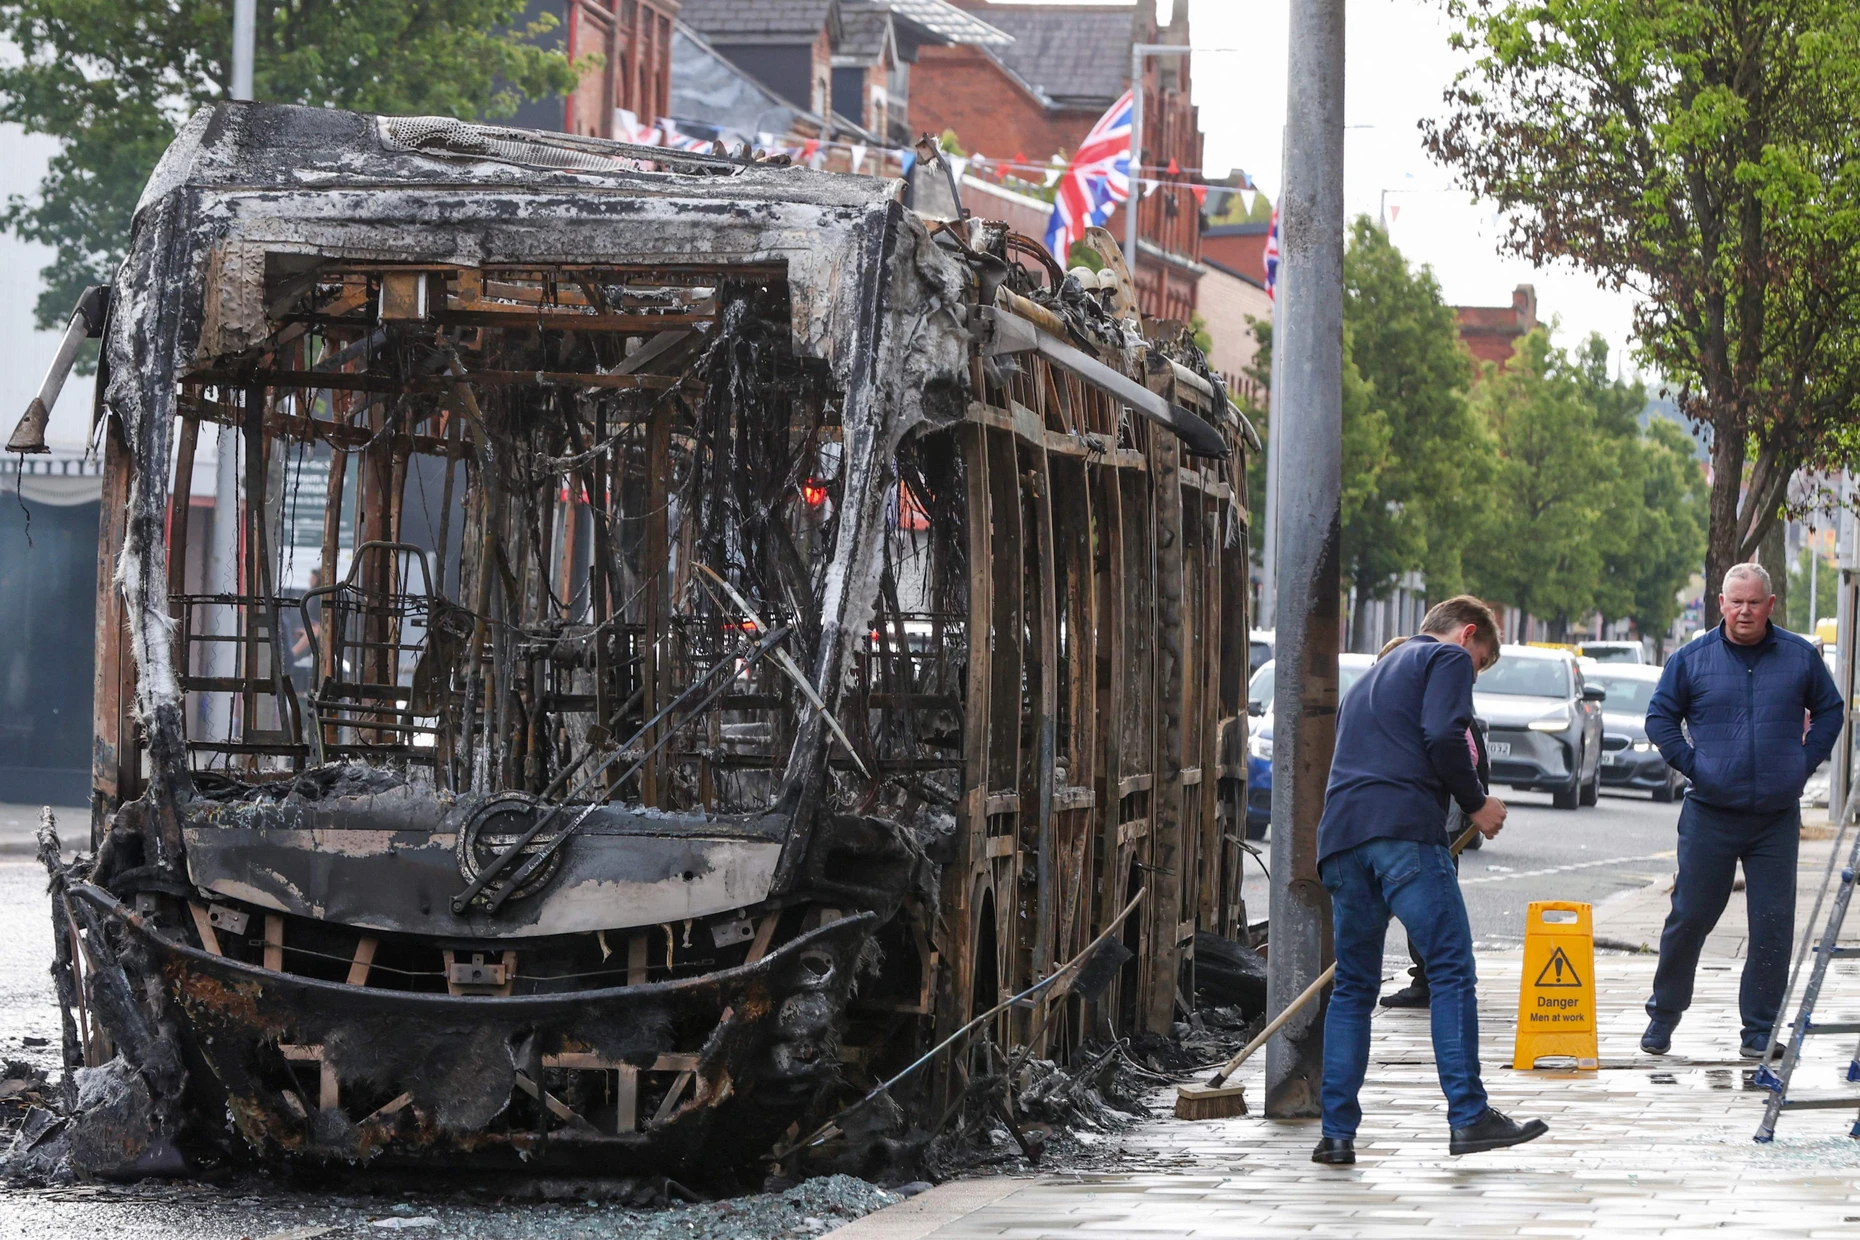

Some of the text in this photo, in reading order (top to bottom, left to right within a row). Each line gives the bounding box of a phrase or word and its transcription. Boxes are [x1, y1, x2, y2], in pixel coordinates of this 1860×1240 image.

[1537, 996, 1579, 1010] Danger
[1530, 1013, 1585, 1022] Men at work
